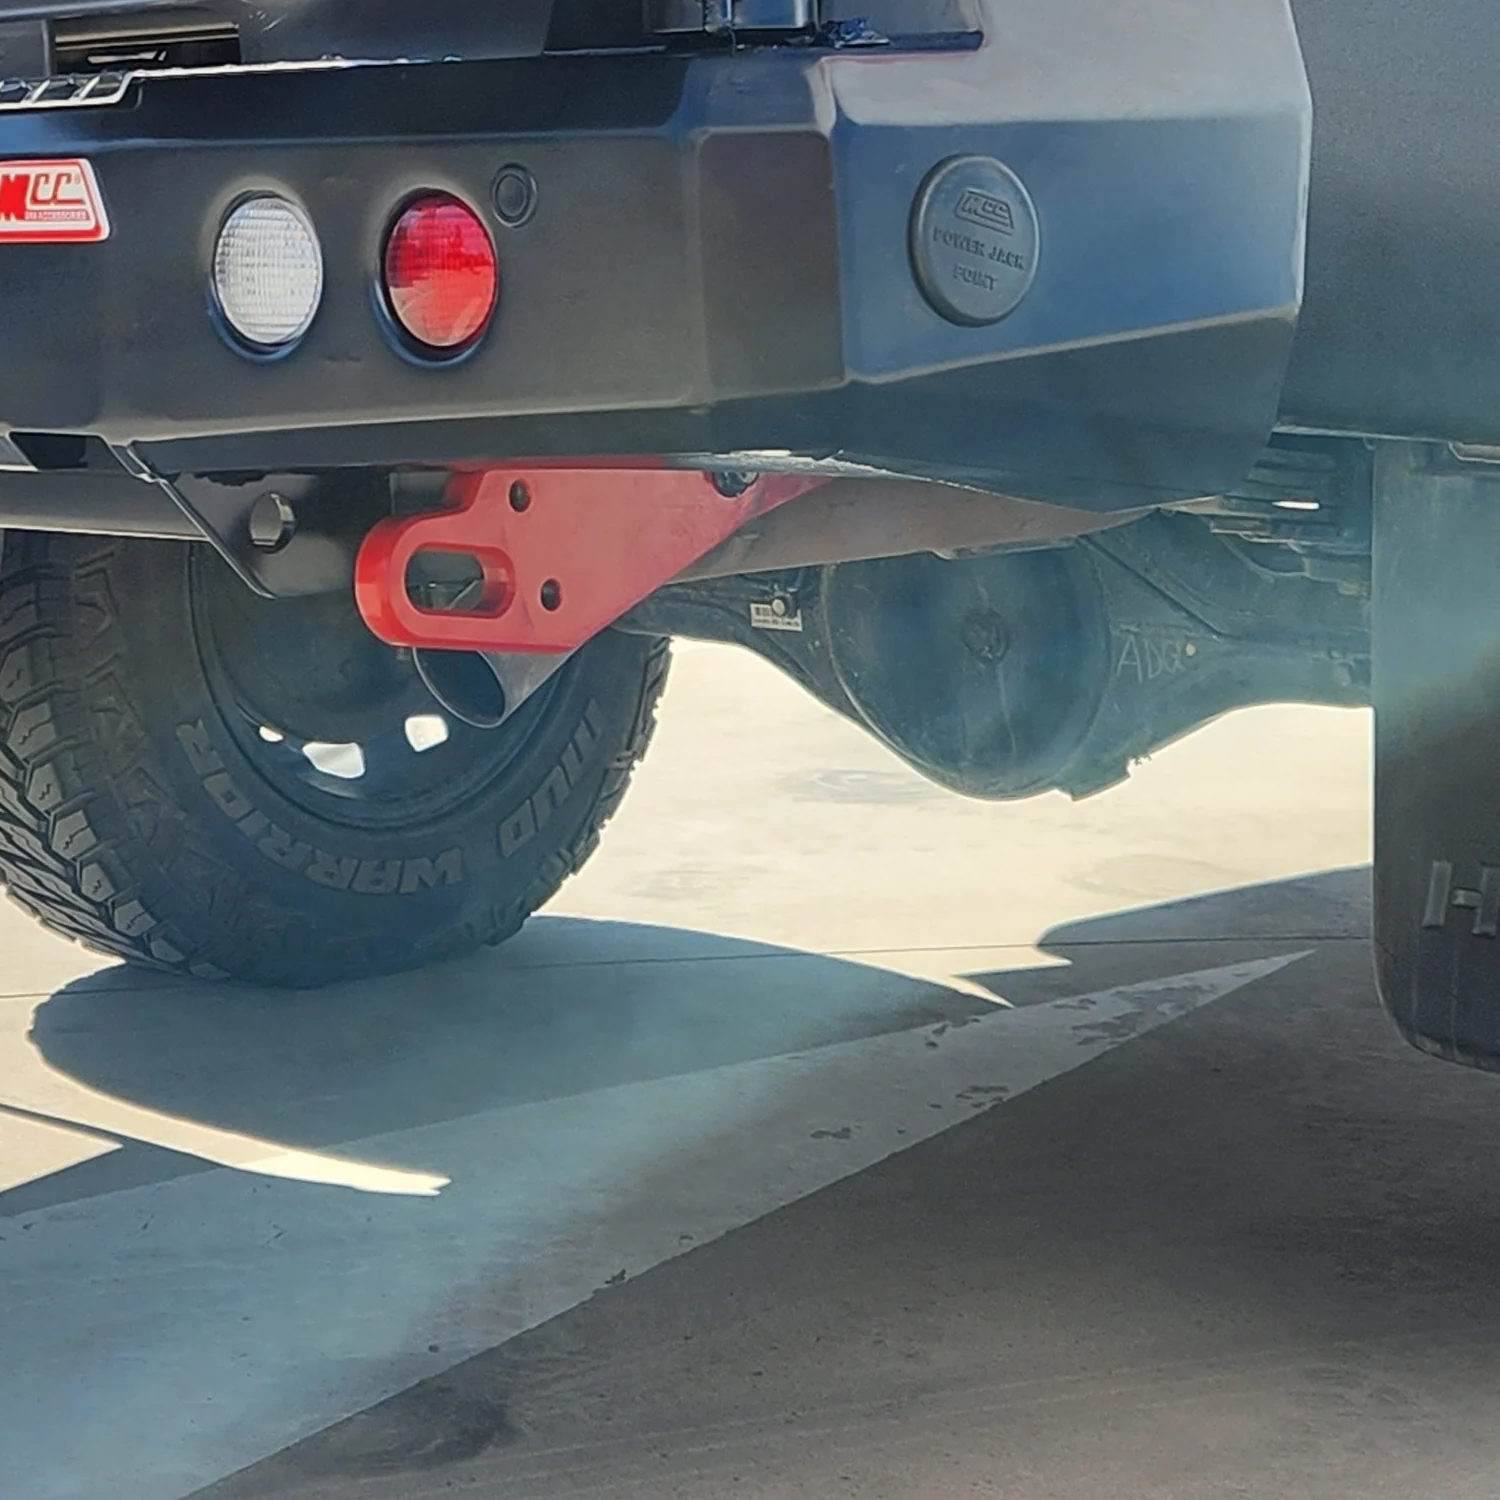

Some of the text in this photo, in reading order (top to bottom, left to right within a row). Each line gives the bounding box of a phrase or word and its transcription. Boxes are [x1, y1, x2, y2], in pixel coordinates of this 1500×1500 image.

[932, 226, 1025, 271] POWER JACK
[174, 718, 465, 895] WARRIOR
